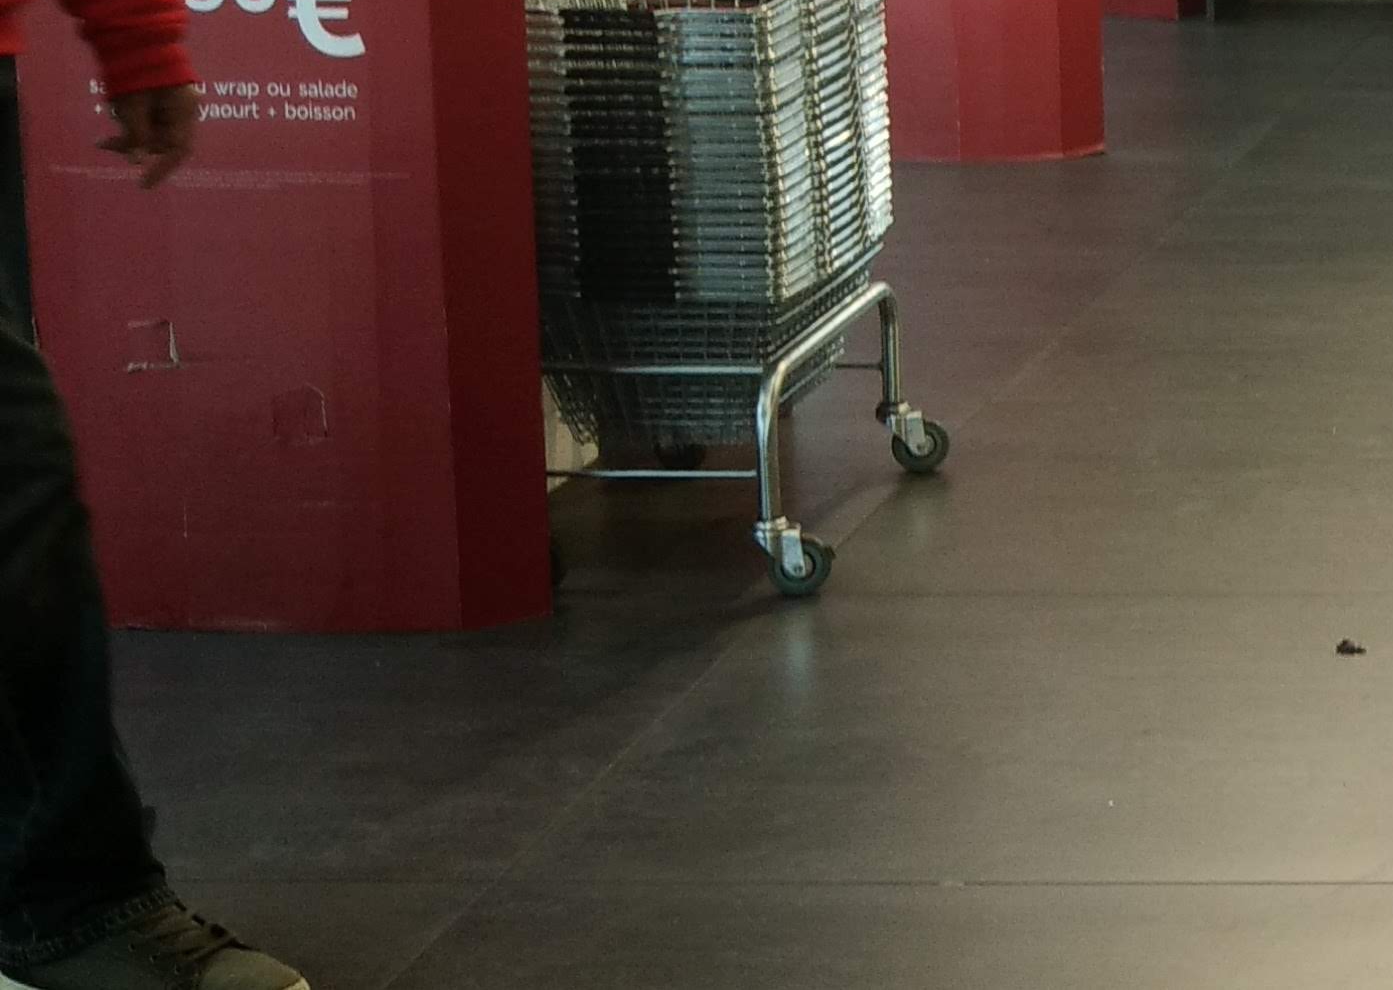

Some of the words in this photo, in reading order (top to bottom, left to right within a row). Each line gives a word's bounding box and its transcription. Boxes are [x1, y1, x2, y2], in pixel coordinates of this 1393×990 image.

[214, 82, 260, 99] wrap
[267, 81, 291, 97] ou
[298, 79, 358, 99] salade
[198, 101, 260, 121] yaourt
[284, 102, 357, 121] boisson
